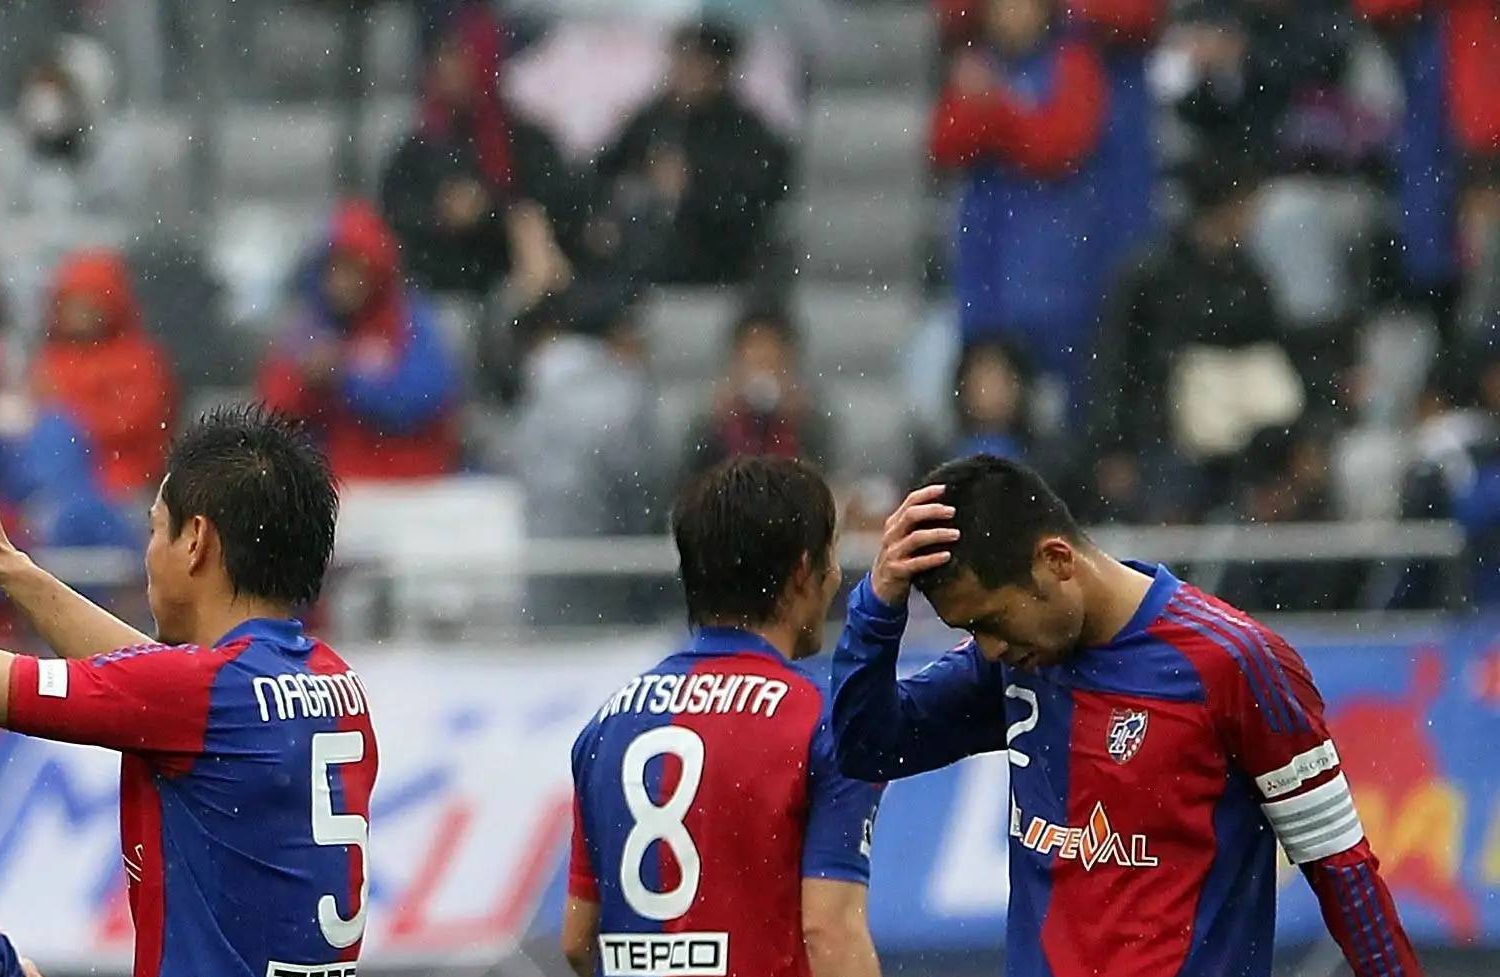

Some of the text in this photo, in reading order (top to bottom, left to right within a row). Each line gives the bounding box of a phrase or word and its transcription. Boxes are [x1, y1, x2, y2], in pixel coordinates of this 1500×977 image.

[253, 670, 365, 721] NAGATO
[311, 731, 371, 948] 5
[620, 725, 705, 921] 8
[1019, 800, 1158, 871] IFEVAL
[605, 940, 719, 970] TEPCO
